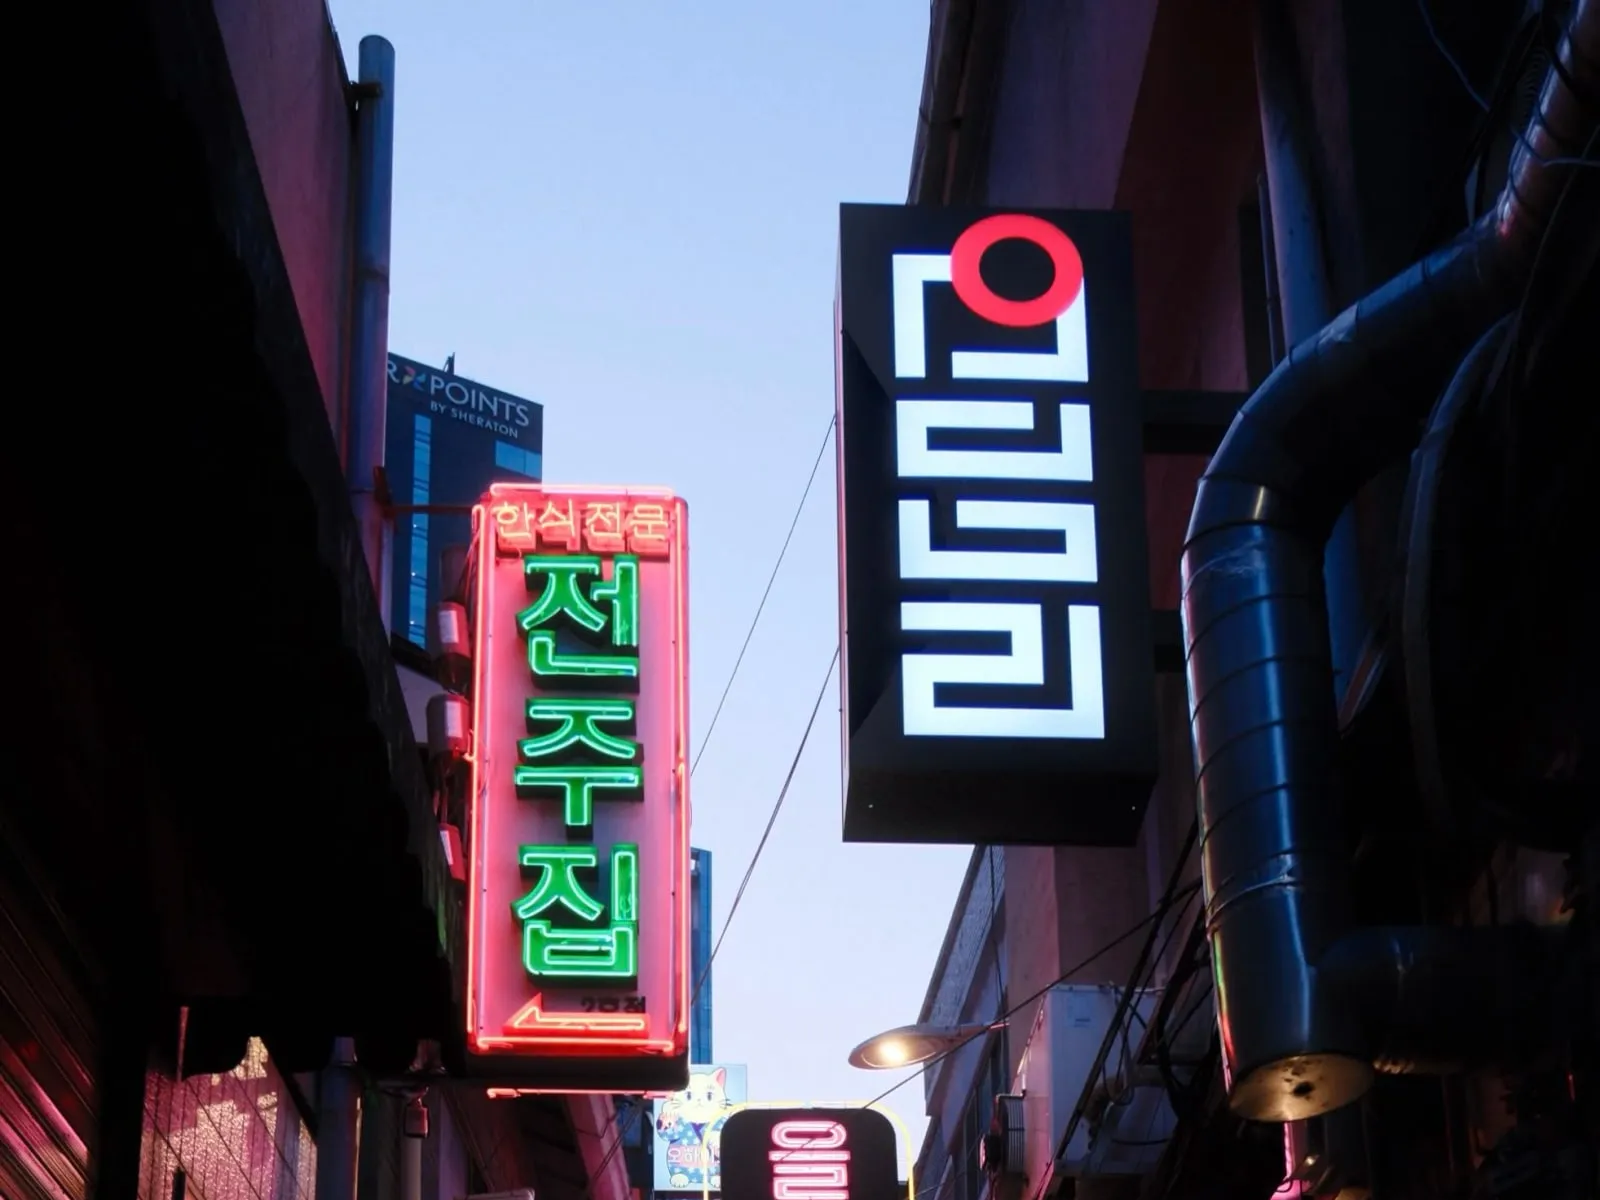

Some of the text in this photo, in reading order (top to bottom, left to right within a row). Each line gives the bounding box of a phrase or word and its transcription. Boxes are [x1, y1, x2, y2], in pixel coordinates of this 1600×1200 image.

[430, 375, 530, 427] POINTS
[430, 401, 519, 439] BY SHERATON
[492, 498, 670, 546] 한식전문
[513, 554, 642, 978] 전주집
